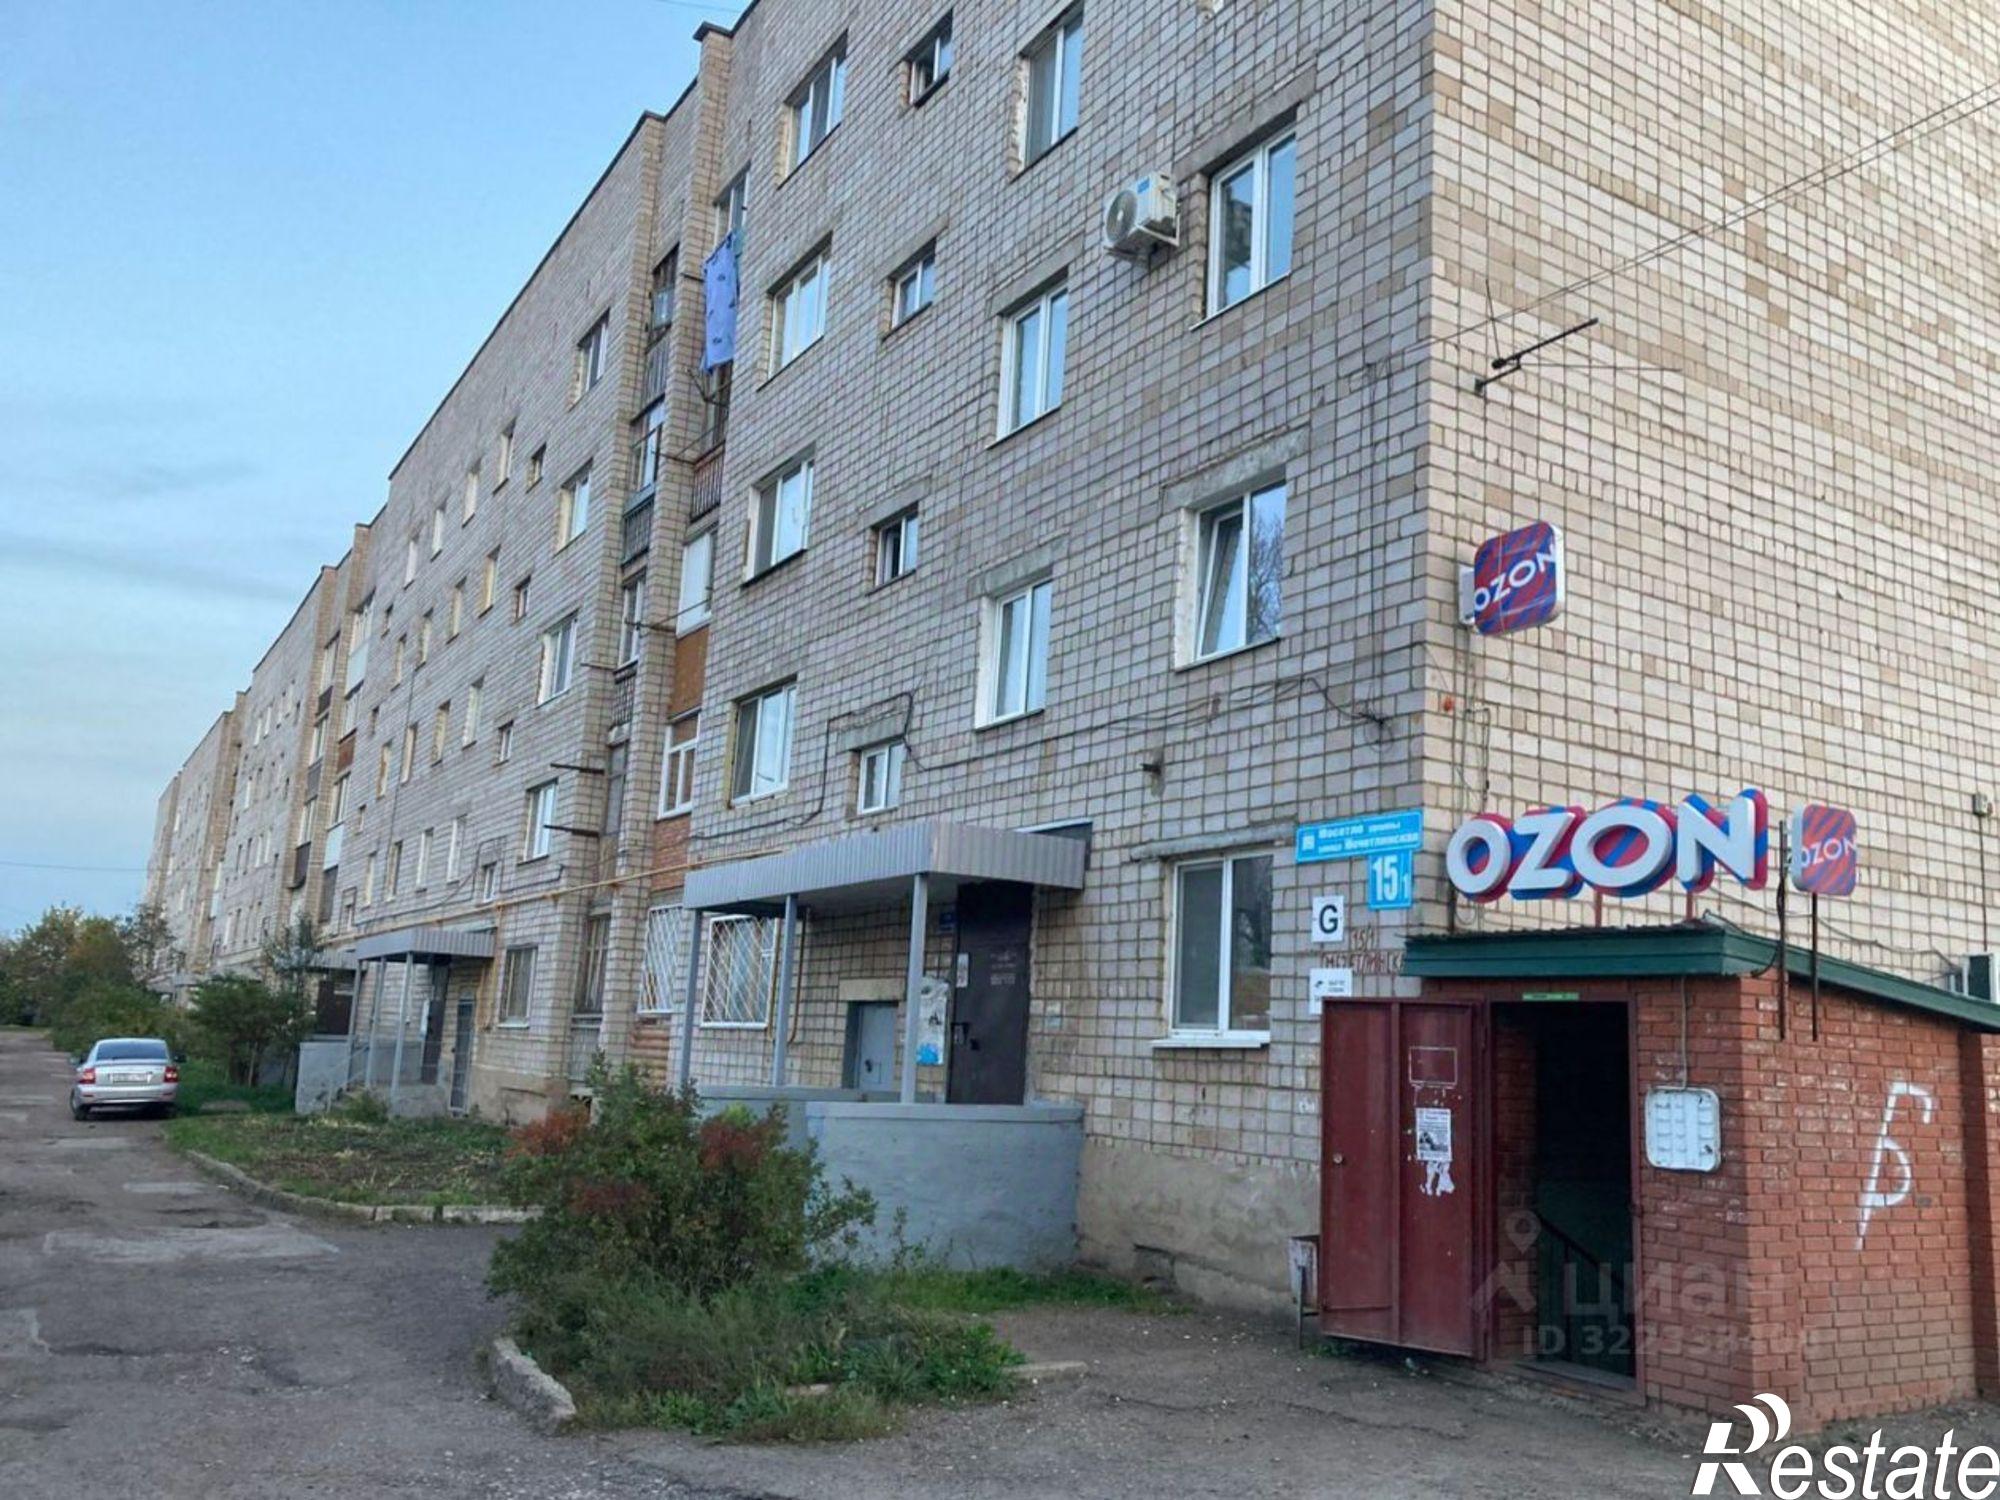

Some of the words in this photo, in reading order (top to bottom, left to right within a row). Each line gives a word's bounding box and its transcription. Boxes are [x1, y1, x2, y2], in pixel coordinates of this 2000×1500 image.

[1474, 544, 1556, 611] OZON
[1446, 788, 1768, 903] OZON
[1373, 854, 1399, 901] 15
[1319, 904, 1338, 934] G
